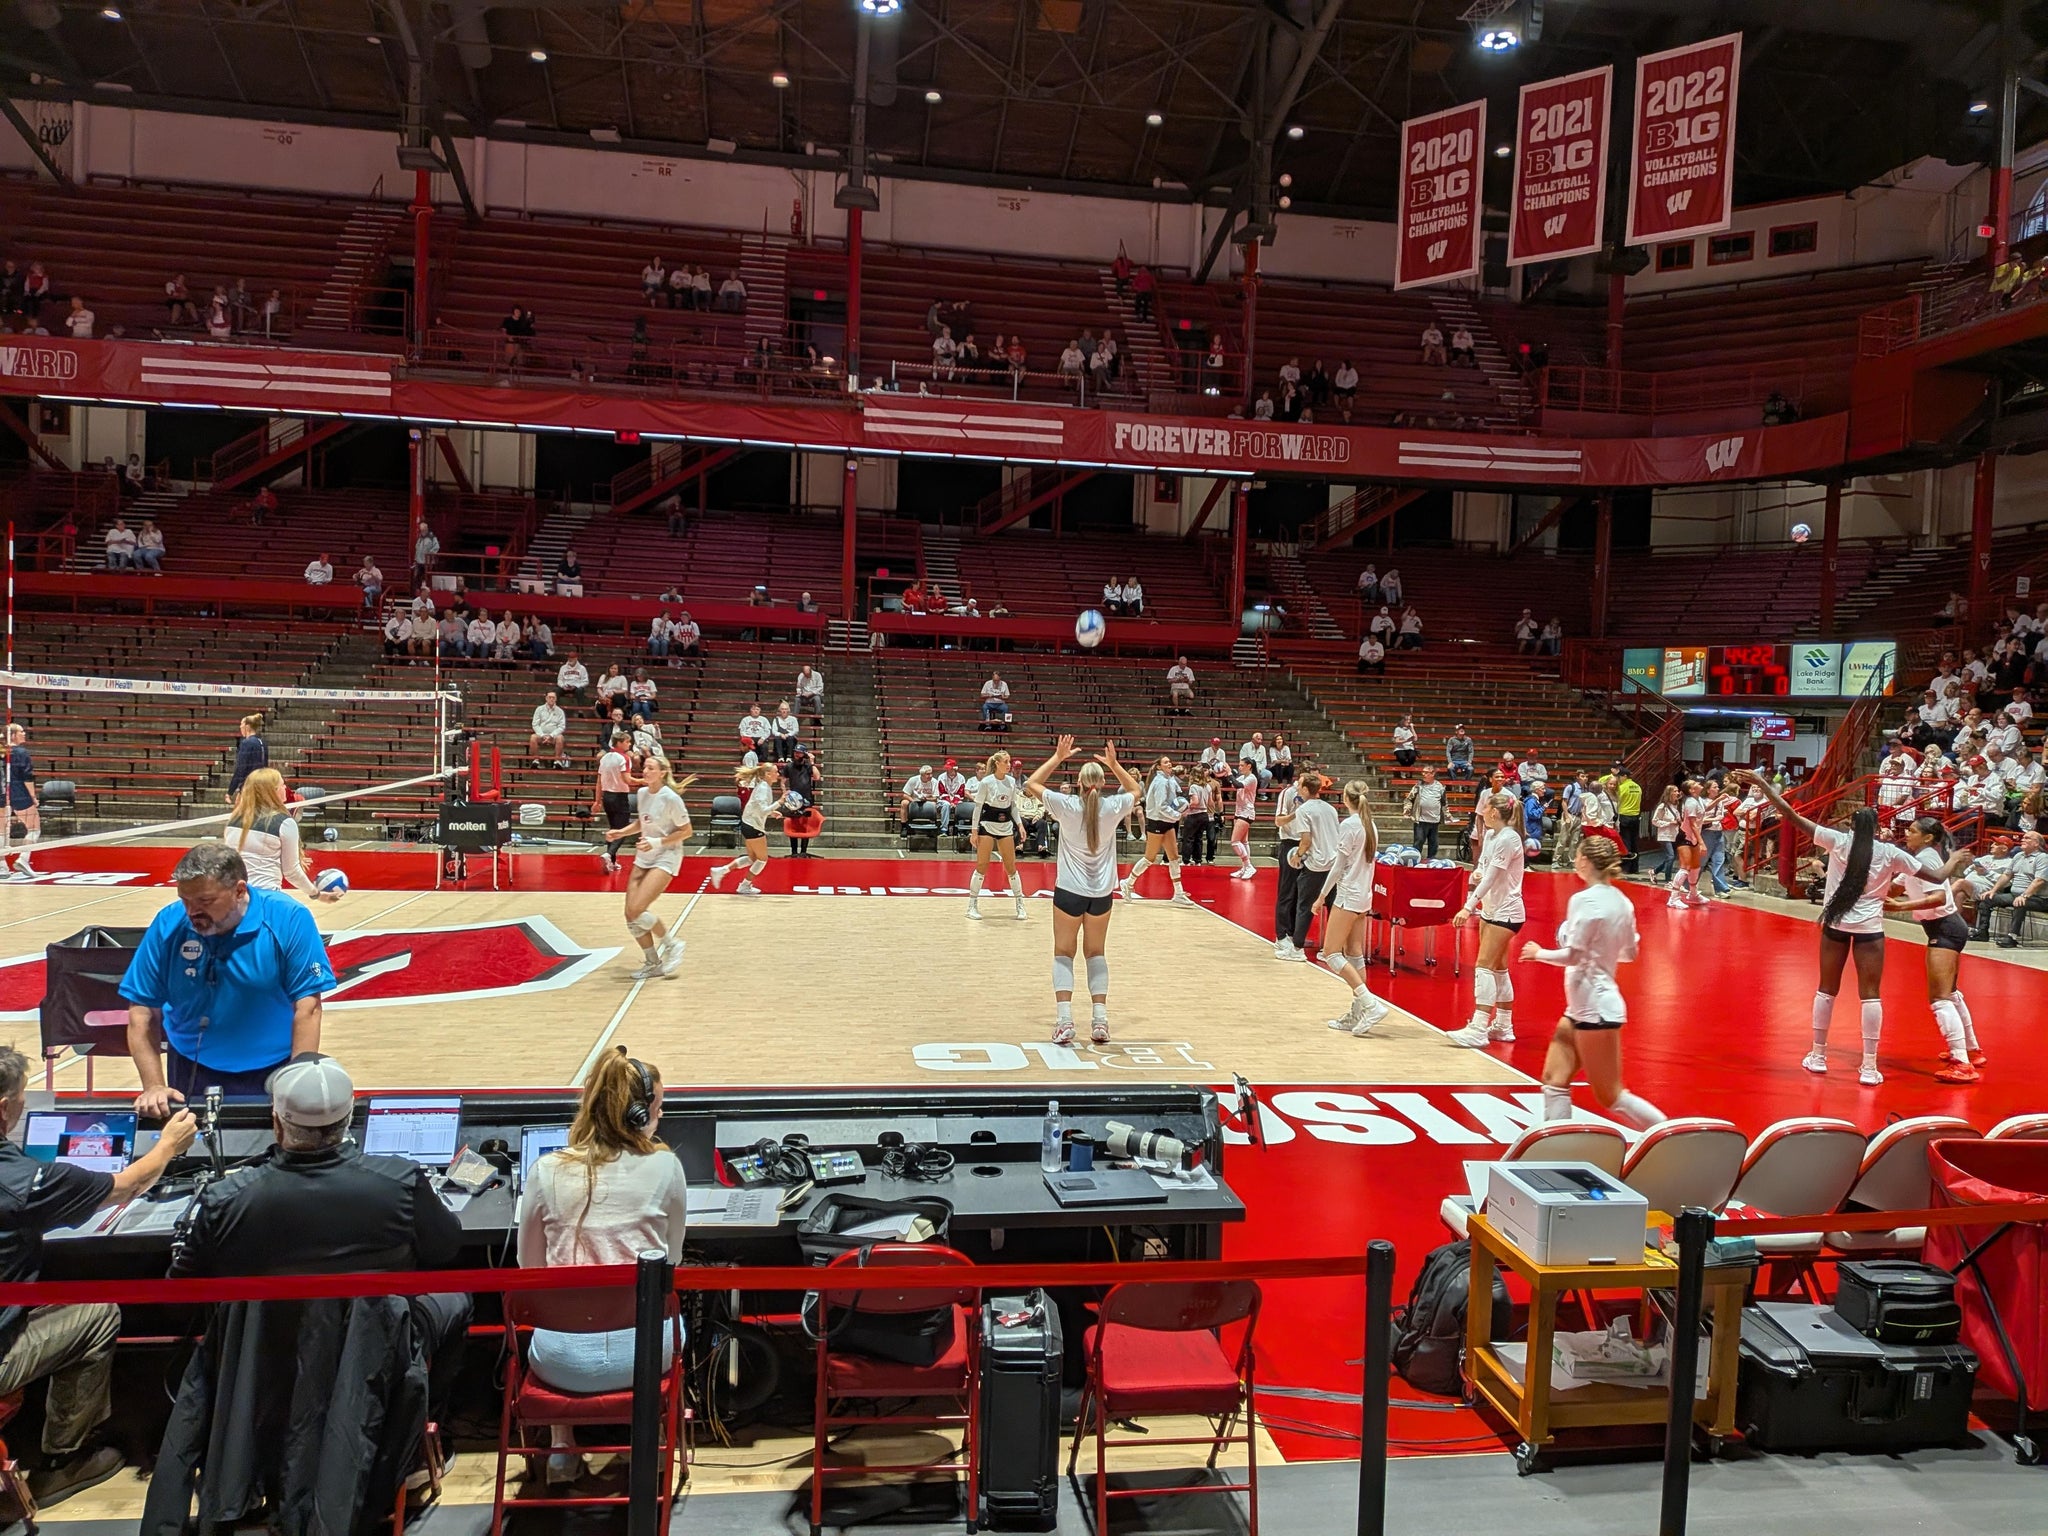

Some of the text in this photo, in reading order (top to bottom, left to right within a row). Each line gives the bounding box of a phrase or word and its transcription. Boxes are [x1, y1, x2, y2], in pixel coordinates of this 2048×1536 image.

[1646, 66, 1726, 118] 2022
[1529, 97, 1593, 144] 2021
[1410, 128, 1473, 175] 2020
[1645, 147, 1718, 172] VOLLEYBALL
[658, 167, 672, 177] RR
[1524, 173, 1591, 196] VOLLEYBALL
[1643, 161, 1717, 188] CHAMPIONS
[1009, 202, 1021, 211] SS
[1523, 187, 1590, 211] CHAMPIONS
[1666, 189, 1693, 216] W
[1410, 201, 1468, 225] VOLLEYBALL
[1408, 213, 1468, 239] CHAMPIONS
[1543, 213, 1568, 239] W
[1426, 239, 1449, 264] W
[1115, 423, 1350, 463] FOREVER FORWARD
[1705, 436, 1745, 474] W
[1721, 676, 1733, 695] 0
[1775, 675, 1789, 695] 0
[1814, 670, 1836, 678] Ridge
[448, 821, 487, 831] molten
